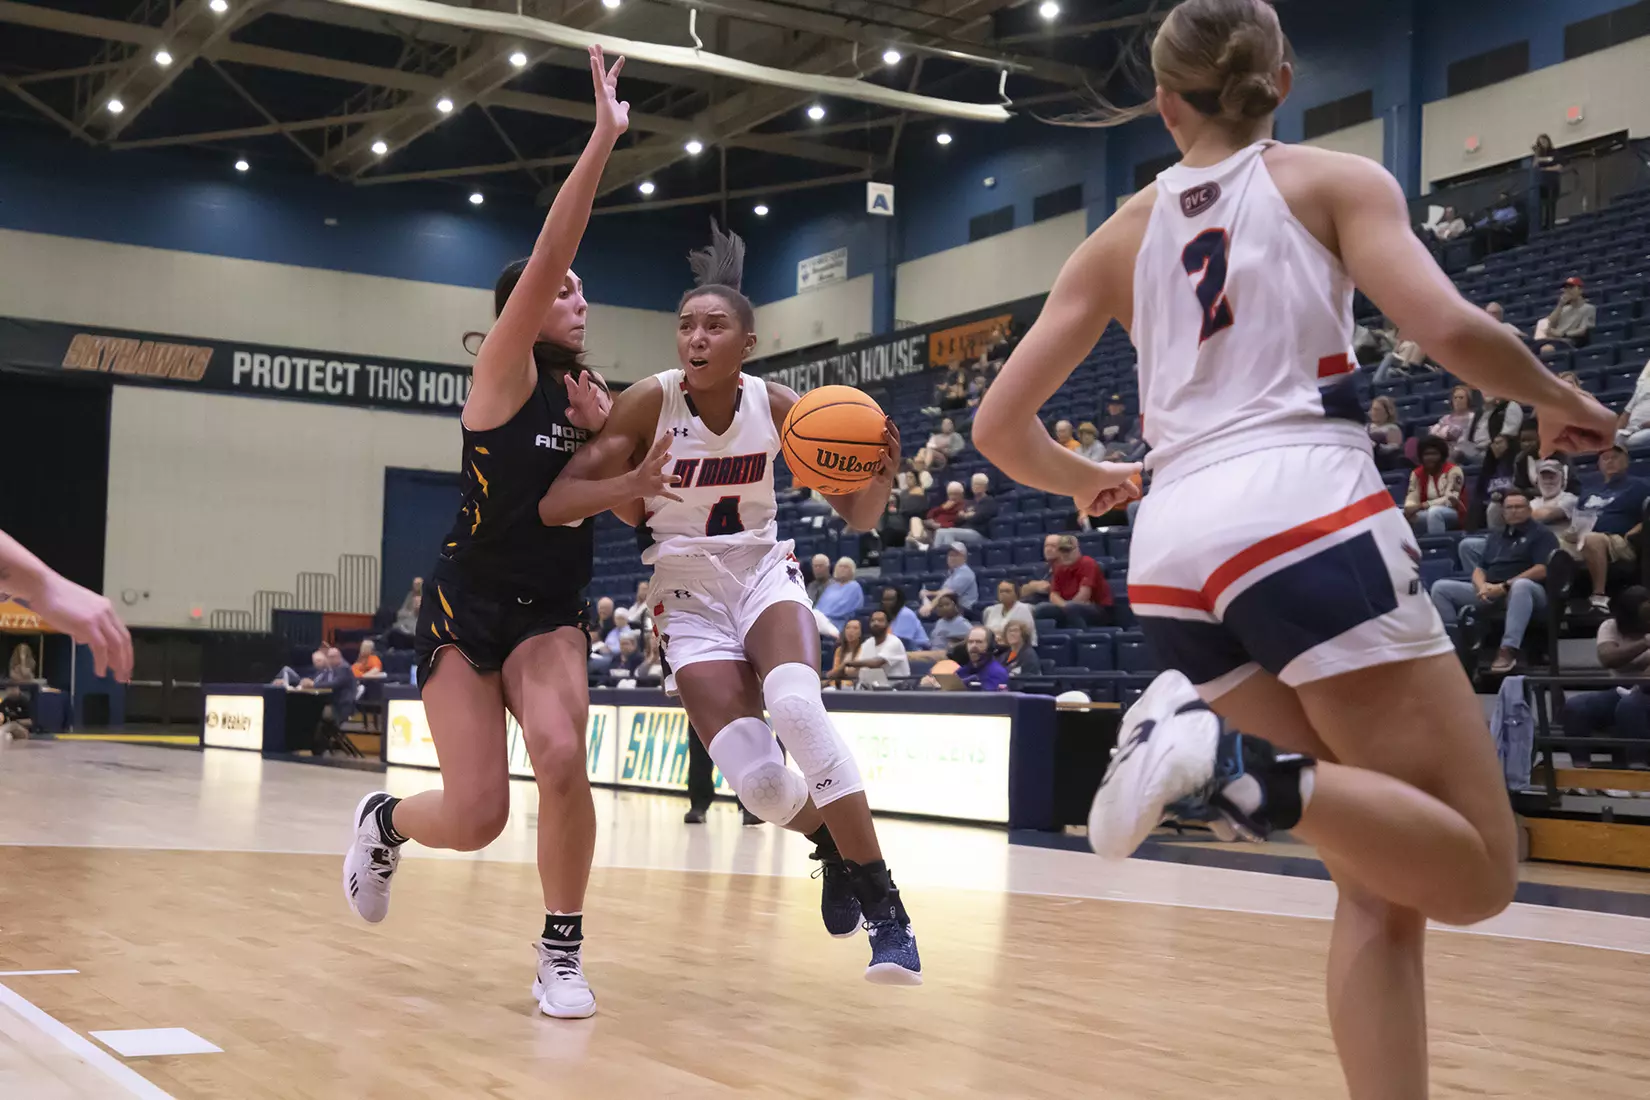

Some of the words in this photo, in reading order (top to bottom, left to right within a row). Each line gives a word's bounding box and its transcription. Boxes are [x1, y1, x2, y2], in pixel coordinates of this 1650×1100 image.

[872, 193, 890, 211] A
[1182, 227, 1234, 346] 2
[62, 333, 214, 382] SKYHAWKS
[232, 351, 360, 397] PROTECT
[366, 365, 413, 401] THIS
[418, 370, 470, 406] HOU
[860, 333, 926, 383] HOUSE
[552, 422, 588, 441] NOR
[669, 458, 701, 489] UT
[695, 451, 768, 488] MARTIN
[705, 495, 745, 537] 4
